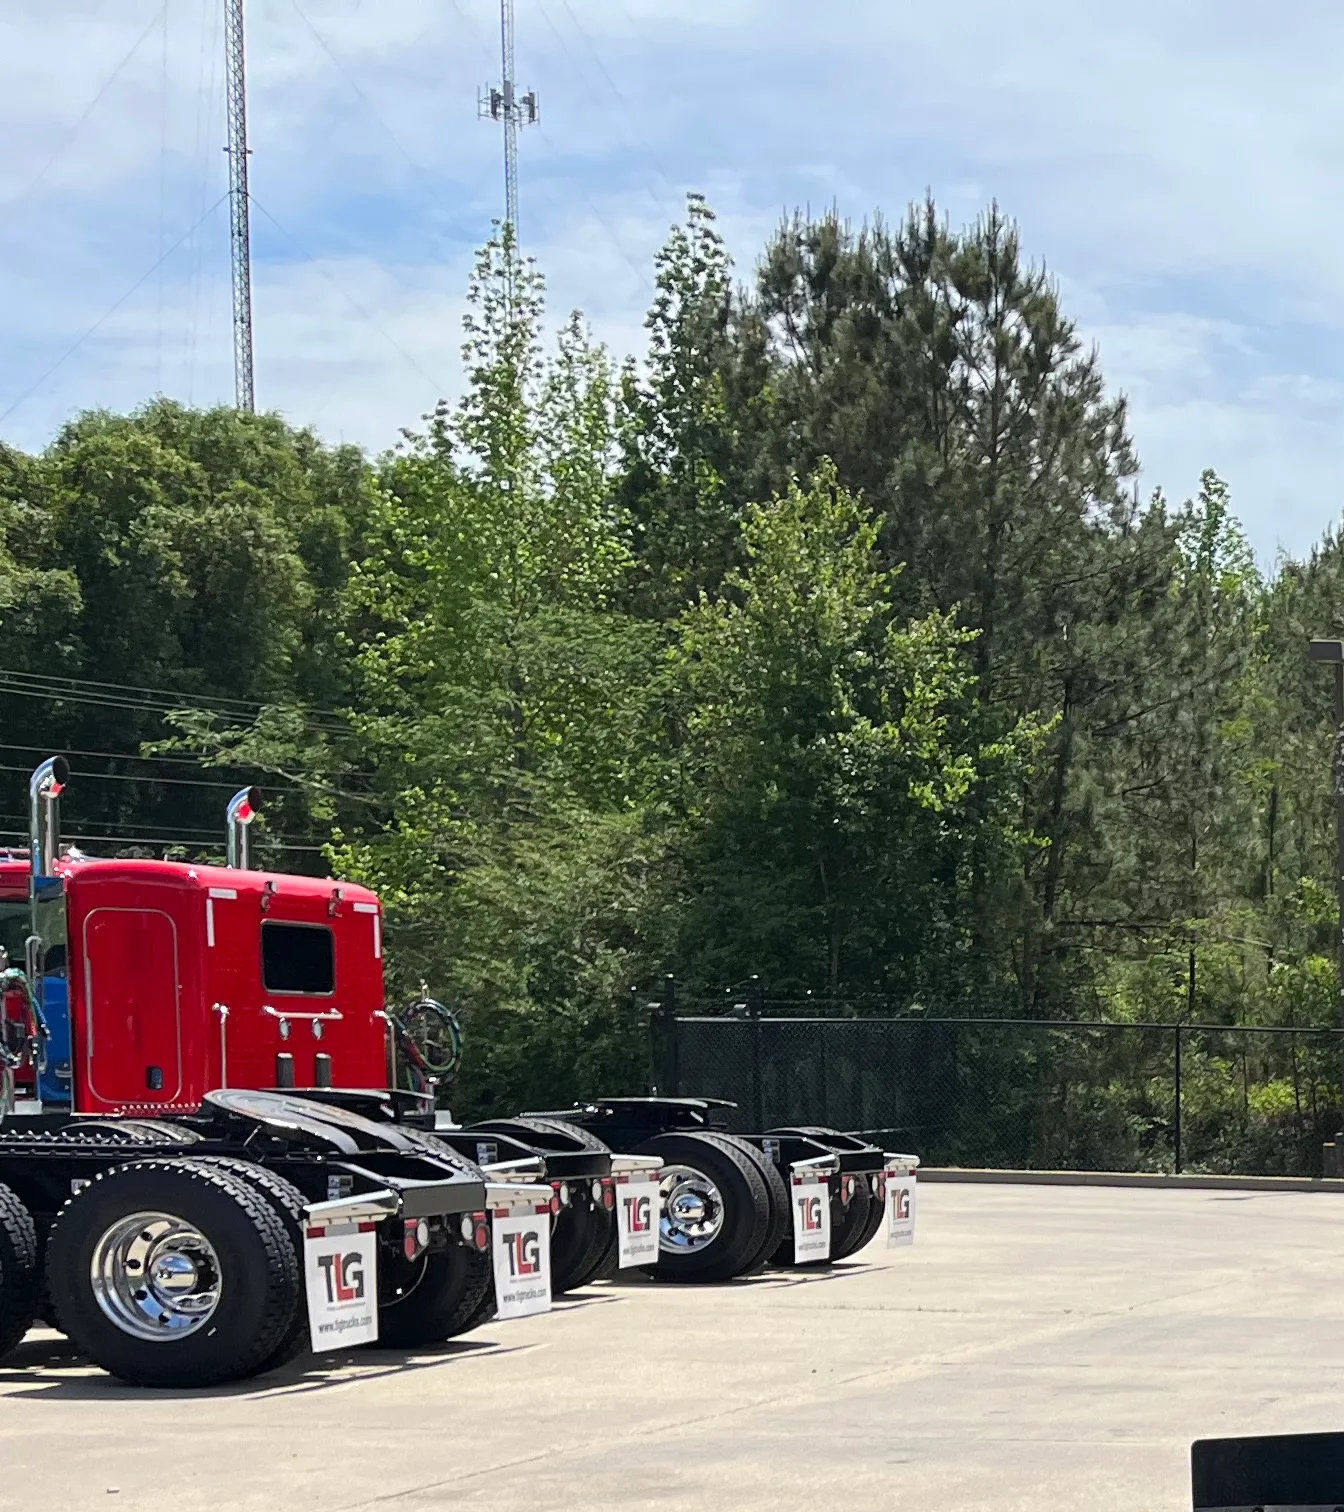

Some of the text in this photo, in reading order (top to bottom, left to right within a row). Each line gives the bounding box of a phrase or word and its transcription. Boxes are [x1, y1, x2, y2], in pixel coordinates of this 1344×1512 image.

[623, 1196, 651, 1233] TLG
[798, 1197, 822, 1231] TLG
[891, 1189, 910, 1221] TLG
[502, 1231, 540, 1276] TLG
[317, 1252, 365, 1303] TLG
